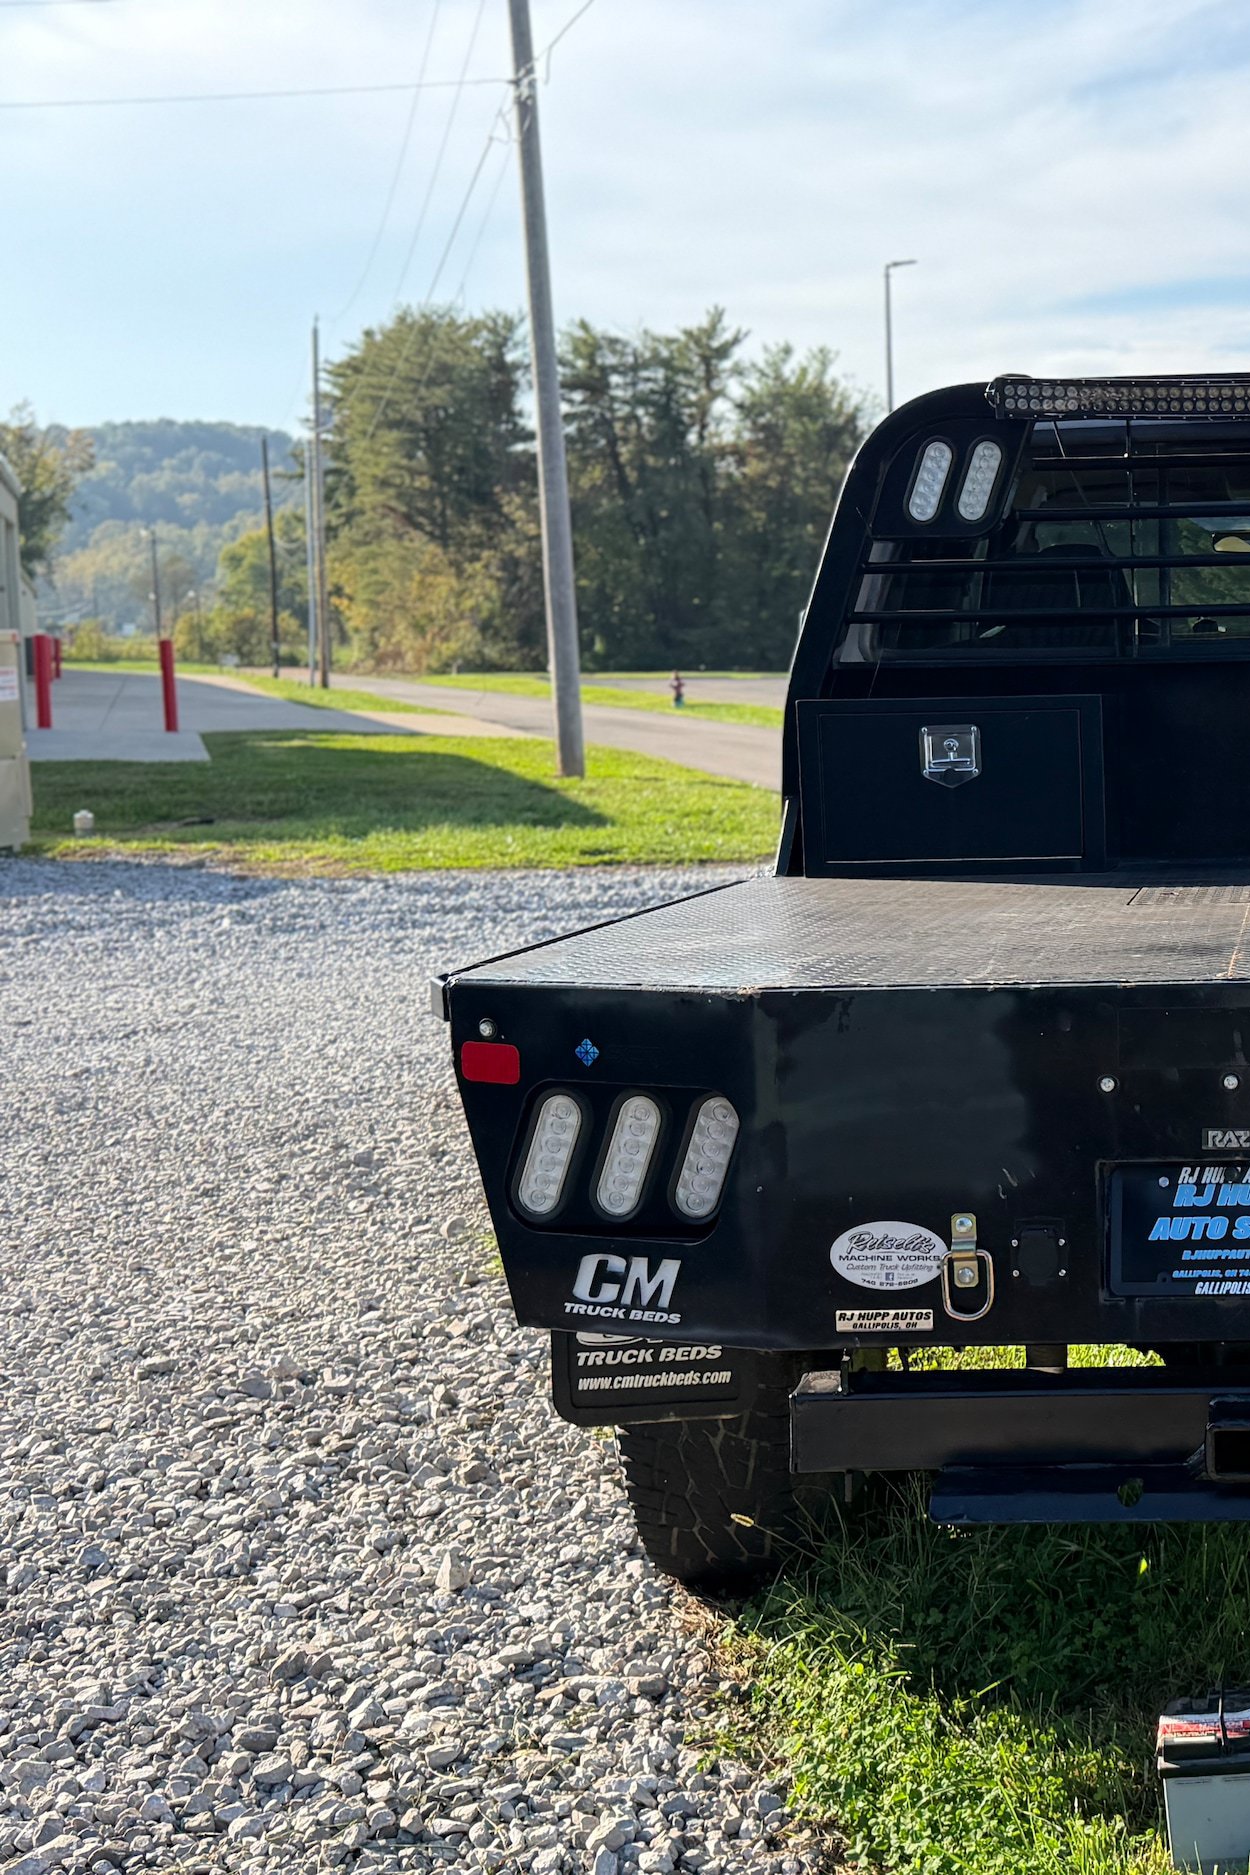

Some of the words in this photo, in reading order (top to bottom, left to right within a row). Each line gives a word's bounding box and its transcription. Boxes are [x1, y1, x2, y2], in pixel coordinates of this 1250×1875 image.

[1178, 1166, 1200, 1184] RJ
[1201, 1166, 1241, 1184] HU
[1173, 1183, 1216, 1207] RJ
[1149, 1217, 1229, 1241] AUTO
[901, 1264, 934, 1272] Upfitting
[1172, 1270, 1223, 1279] GALLIPOLIS,
[1224, 1270, 1237, 1278] OH
[572, 1253, 681, 1308] CM
[564, 1302, 627, 1320] TRUCK
[628, 1309, 682, 1325] BEDS
[838, 1313, 855, 1321] RJ
[857, 1312, 890, 1321] HUPP
[892, 1311, 932, 1321] AUTOS
[852, 1322, 901, 1330] GALLIPOLIS,
[577, 1349, 654, 1367] TRUCK
[659, 1345, 723, 1362] BEDS
[578, 1370, 732, 1391] www.cmtruckbeds.com
